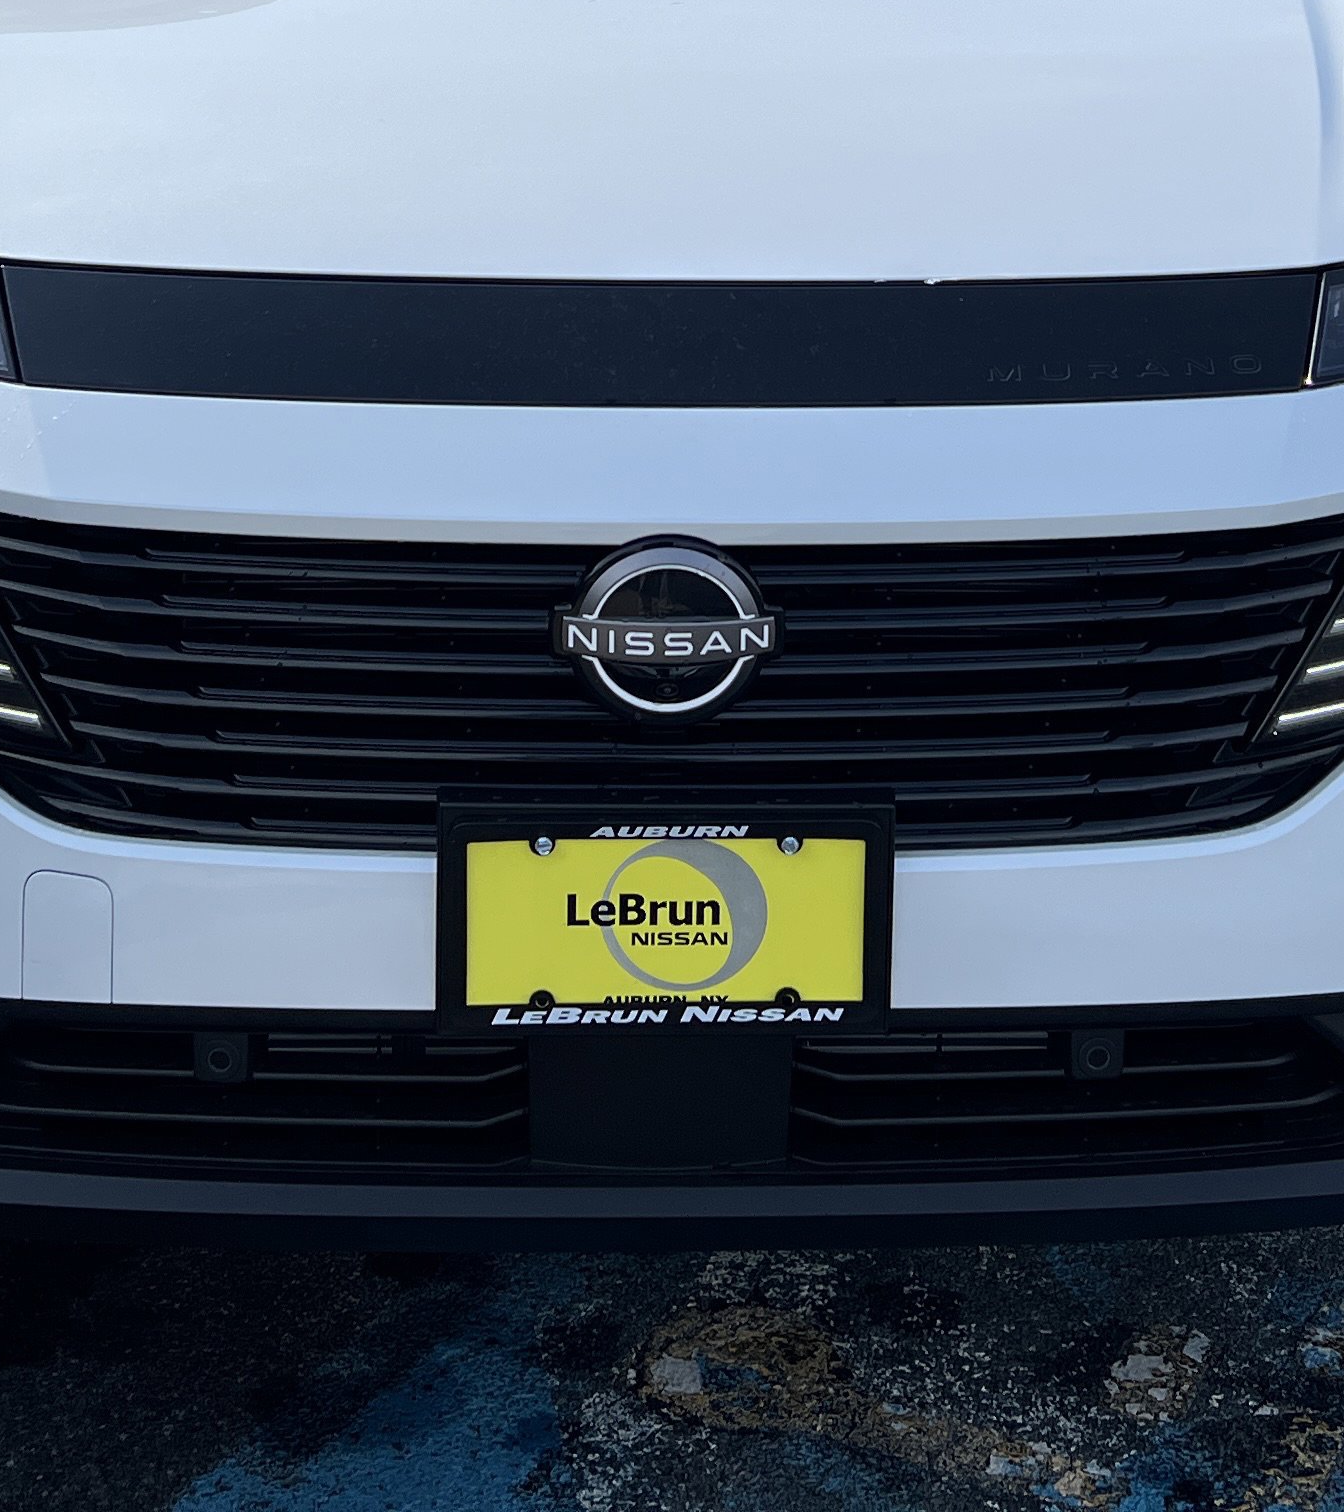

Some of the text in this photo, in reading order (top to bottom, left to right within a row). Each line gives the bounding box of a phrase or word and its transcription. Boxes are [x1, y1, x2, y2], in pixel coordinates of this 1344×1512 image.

[987, 354, 1262, 382] MURANO
[567, 624, 769, 656] NISSAN
[589, 825, 749, 838] AUBURN
[566, 893, 721, 926] LeBrun
[631, 931, 728, 946] NISSAN
